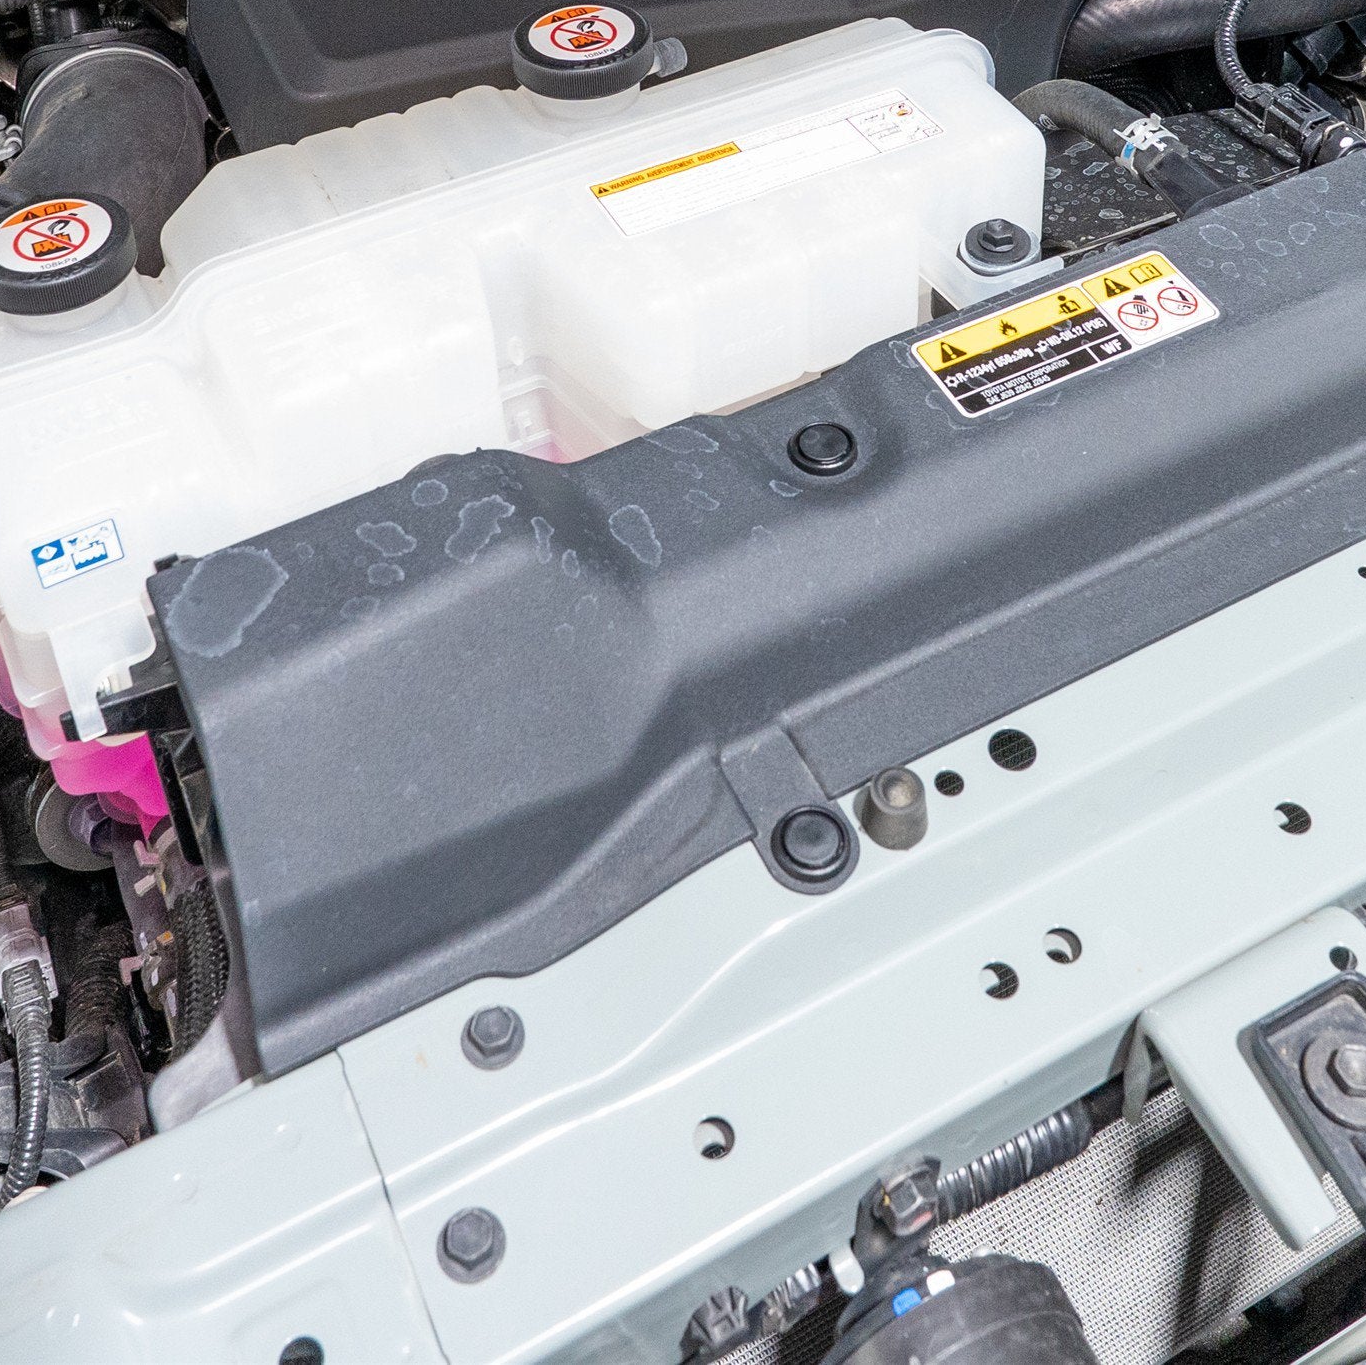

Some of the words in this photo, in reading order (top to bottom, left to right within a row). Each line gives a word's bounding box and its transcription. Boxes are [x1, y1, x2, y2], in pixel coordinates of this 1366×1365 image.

[610, 174, 645, 190] WARNING
[647, 159, 695, 178] AVERTISSEMENT
[697, 145, 735, 163] ADVERTENCIA
[40, 256, 78, 270] 108kPa
[956, 360, 996, 383] R-1234yf
[997, 347, 1035, 369] 650±30g
[1085, 315, 1107, 336] (POE)
[1102, 340, 1123, 355] WF
[981, 384, 1004, 399] TOYOTA
[1003, 375, 1029, 391] MOTOR
[1028, 358, 1069, 381] CORPORATION
[987, 393, 1001, 406] SAE
[1015, 381, 1033, 395] J2842
